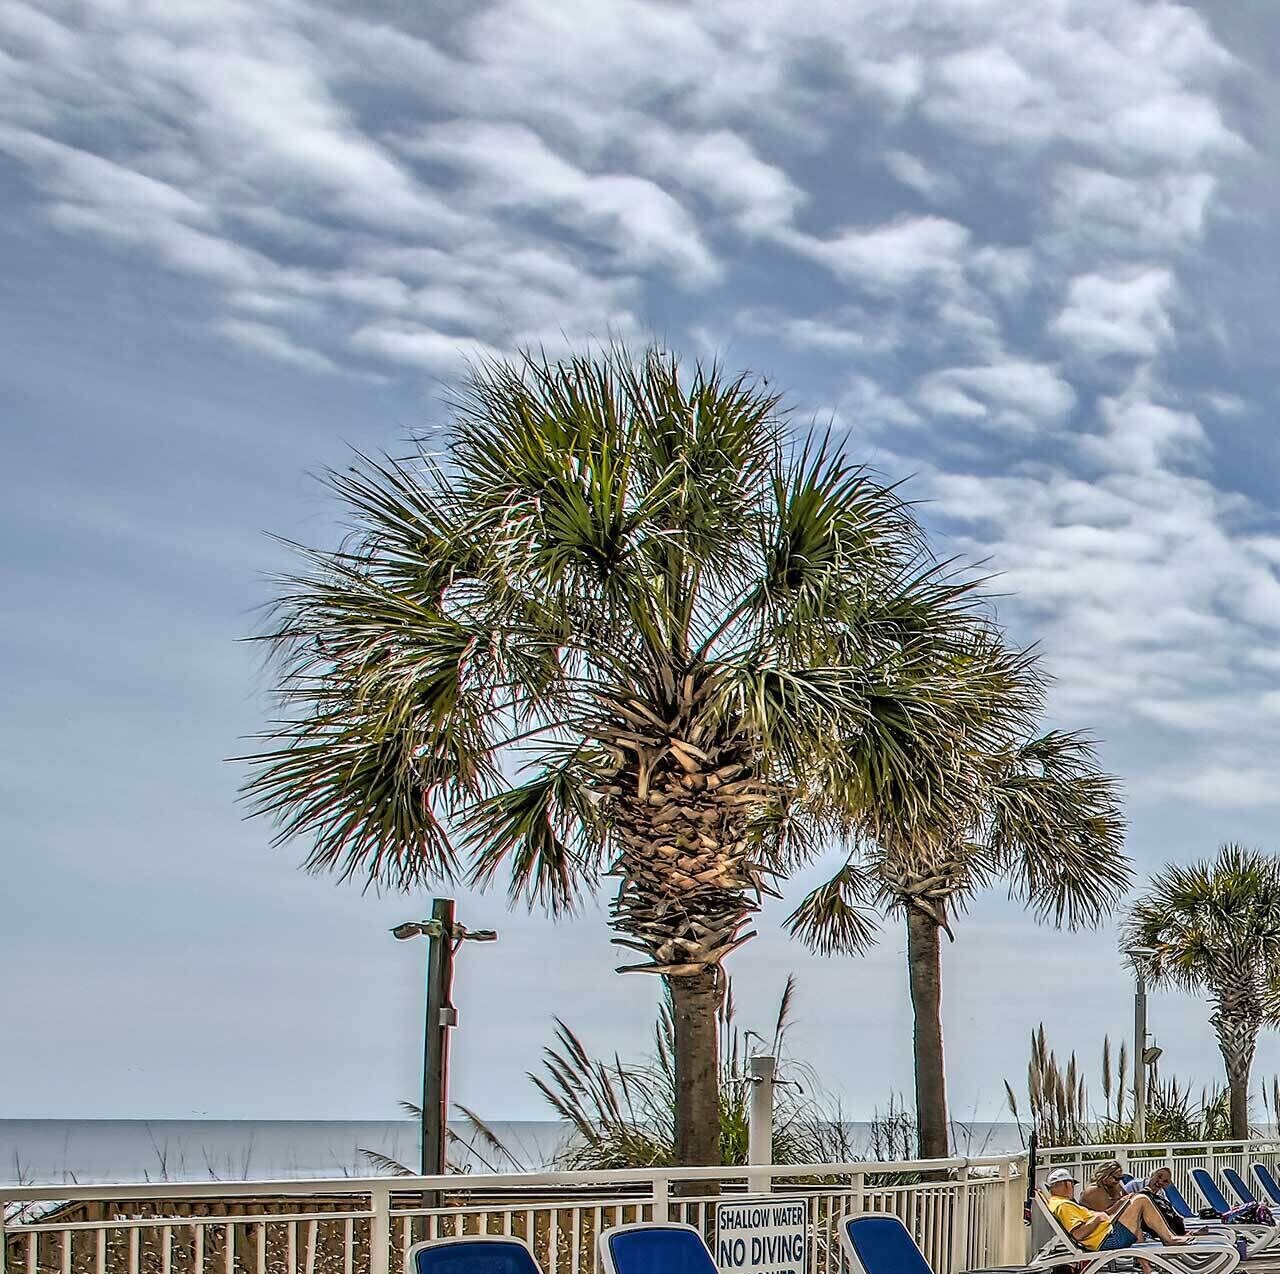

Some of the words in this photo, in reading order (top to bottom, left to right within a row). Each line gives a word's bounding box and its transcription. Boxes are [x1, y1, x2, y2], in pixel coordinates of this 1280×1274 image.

[720, 1208, 770, 1230] SHALLOW
[772, 1206, 803, 1227] WATER
[720, 1238, 746, 1268] NO
[751, 1234, 803, 1266] DIVING
